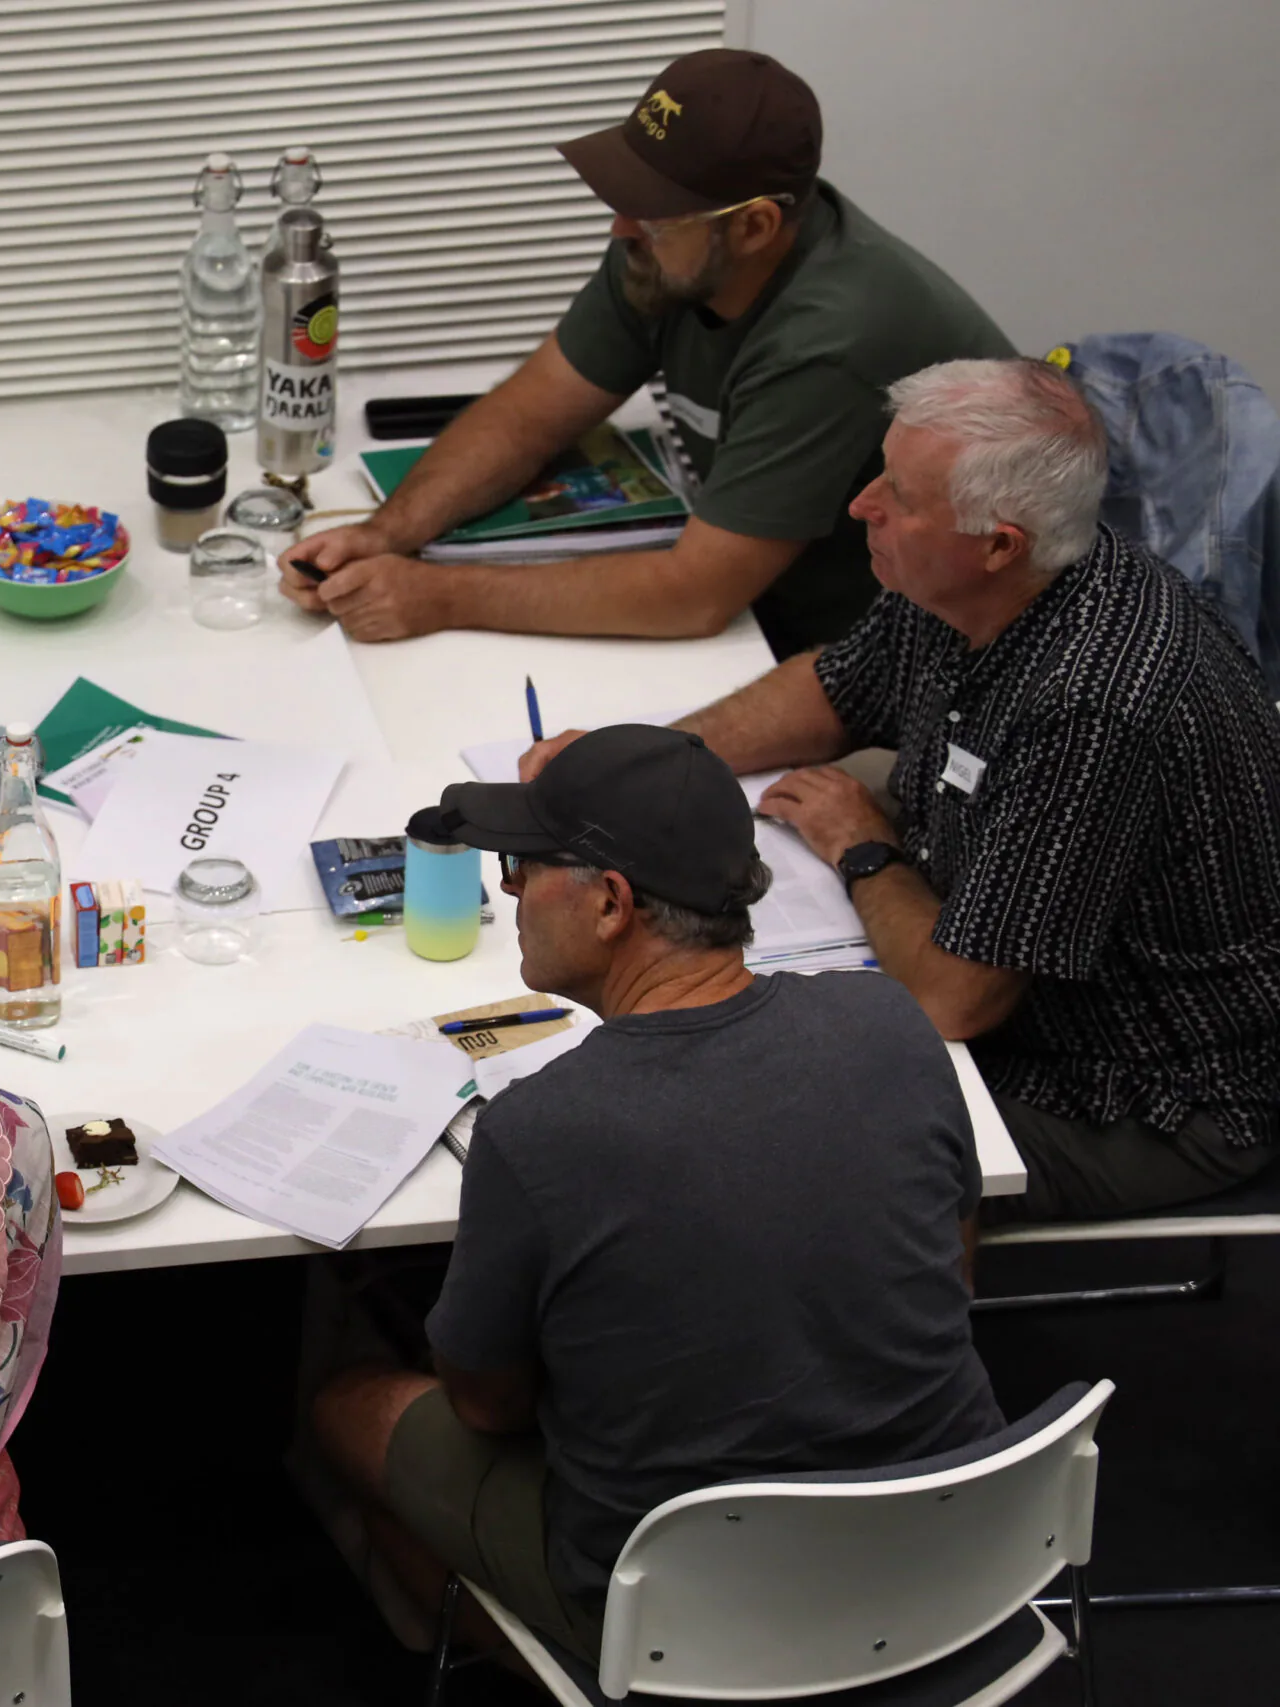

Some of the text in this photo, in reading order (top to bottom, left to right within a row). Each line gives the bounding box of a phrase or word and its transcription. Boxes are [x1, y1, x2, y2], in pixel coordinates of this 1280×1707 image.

[268, 368, 332, 398] YAKA
[180, 772, 241, 851] GROUP 4
